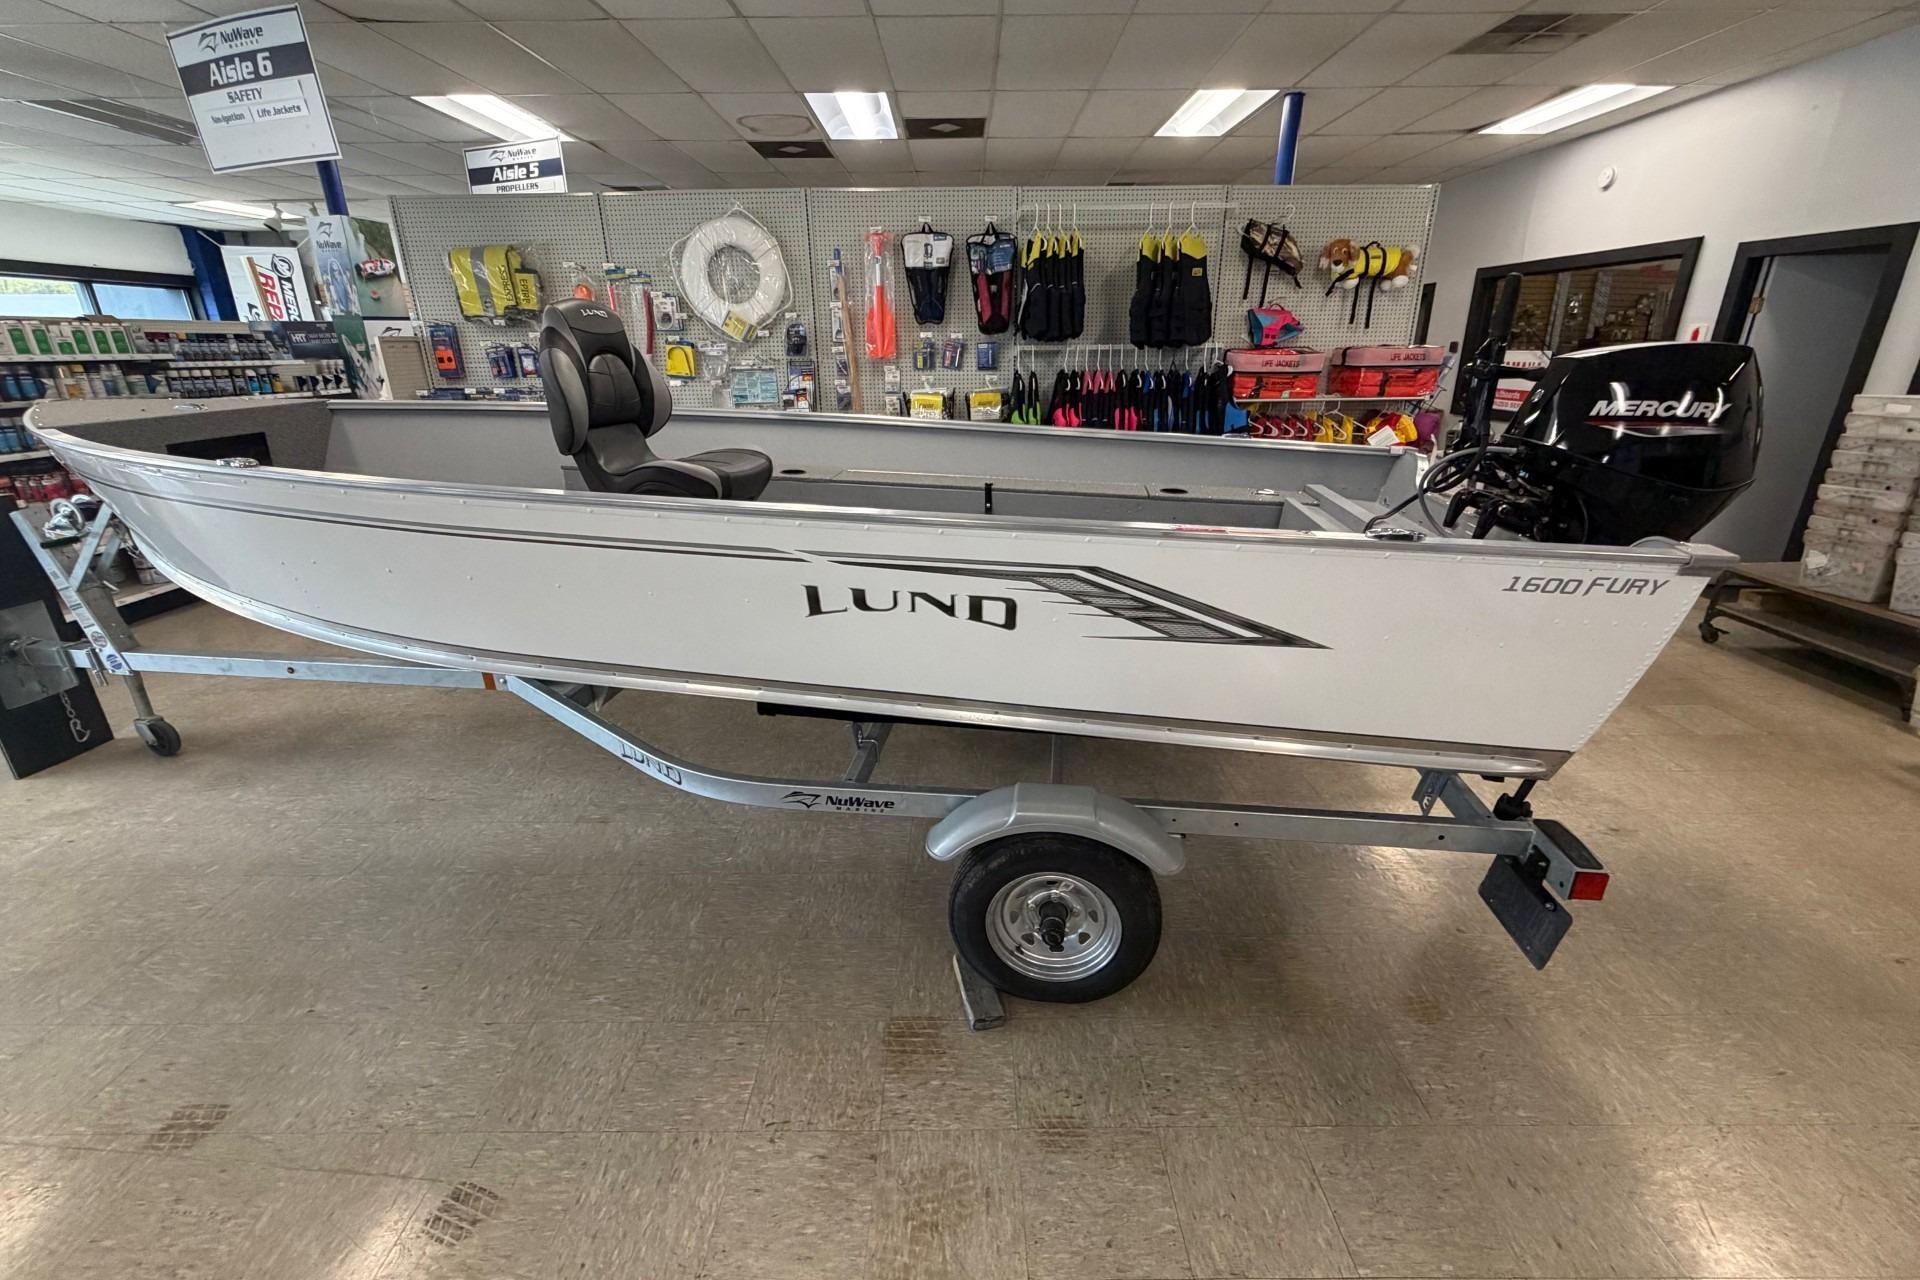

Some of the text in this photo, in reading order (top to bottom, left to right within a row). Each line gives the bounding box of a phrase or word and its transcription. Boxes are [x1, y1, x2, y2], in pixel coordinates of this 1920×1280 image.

[220, 25, 264, 45] NuWave
[209, 51, 274, 87] Aisle 6
[226, 88, 263, 104] SAFETY
[256, 107, 272, 119] Life
[272, 104, 302, 117] Jackets
[507, 148, 537, 158] NuWave
[492, 162, 540, 182] Aisle 5
[496, 182, 540, 193] PROPELLERS
[258, 272, 285, 321] REP
[580, 308, 609, 319] LUND
[1403, 353, 1426, 361] JACKETS
[1588, 400, 1732, 419] MERCURY
[1501, 576, 1671, 597] 1600 FURY
[800, 584, 1018, 631] LUND
[621, 743, 682, 785] LUND
[825, 795, 895, 809] NuWave
